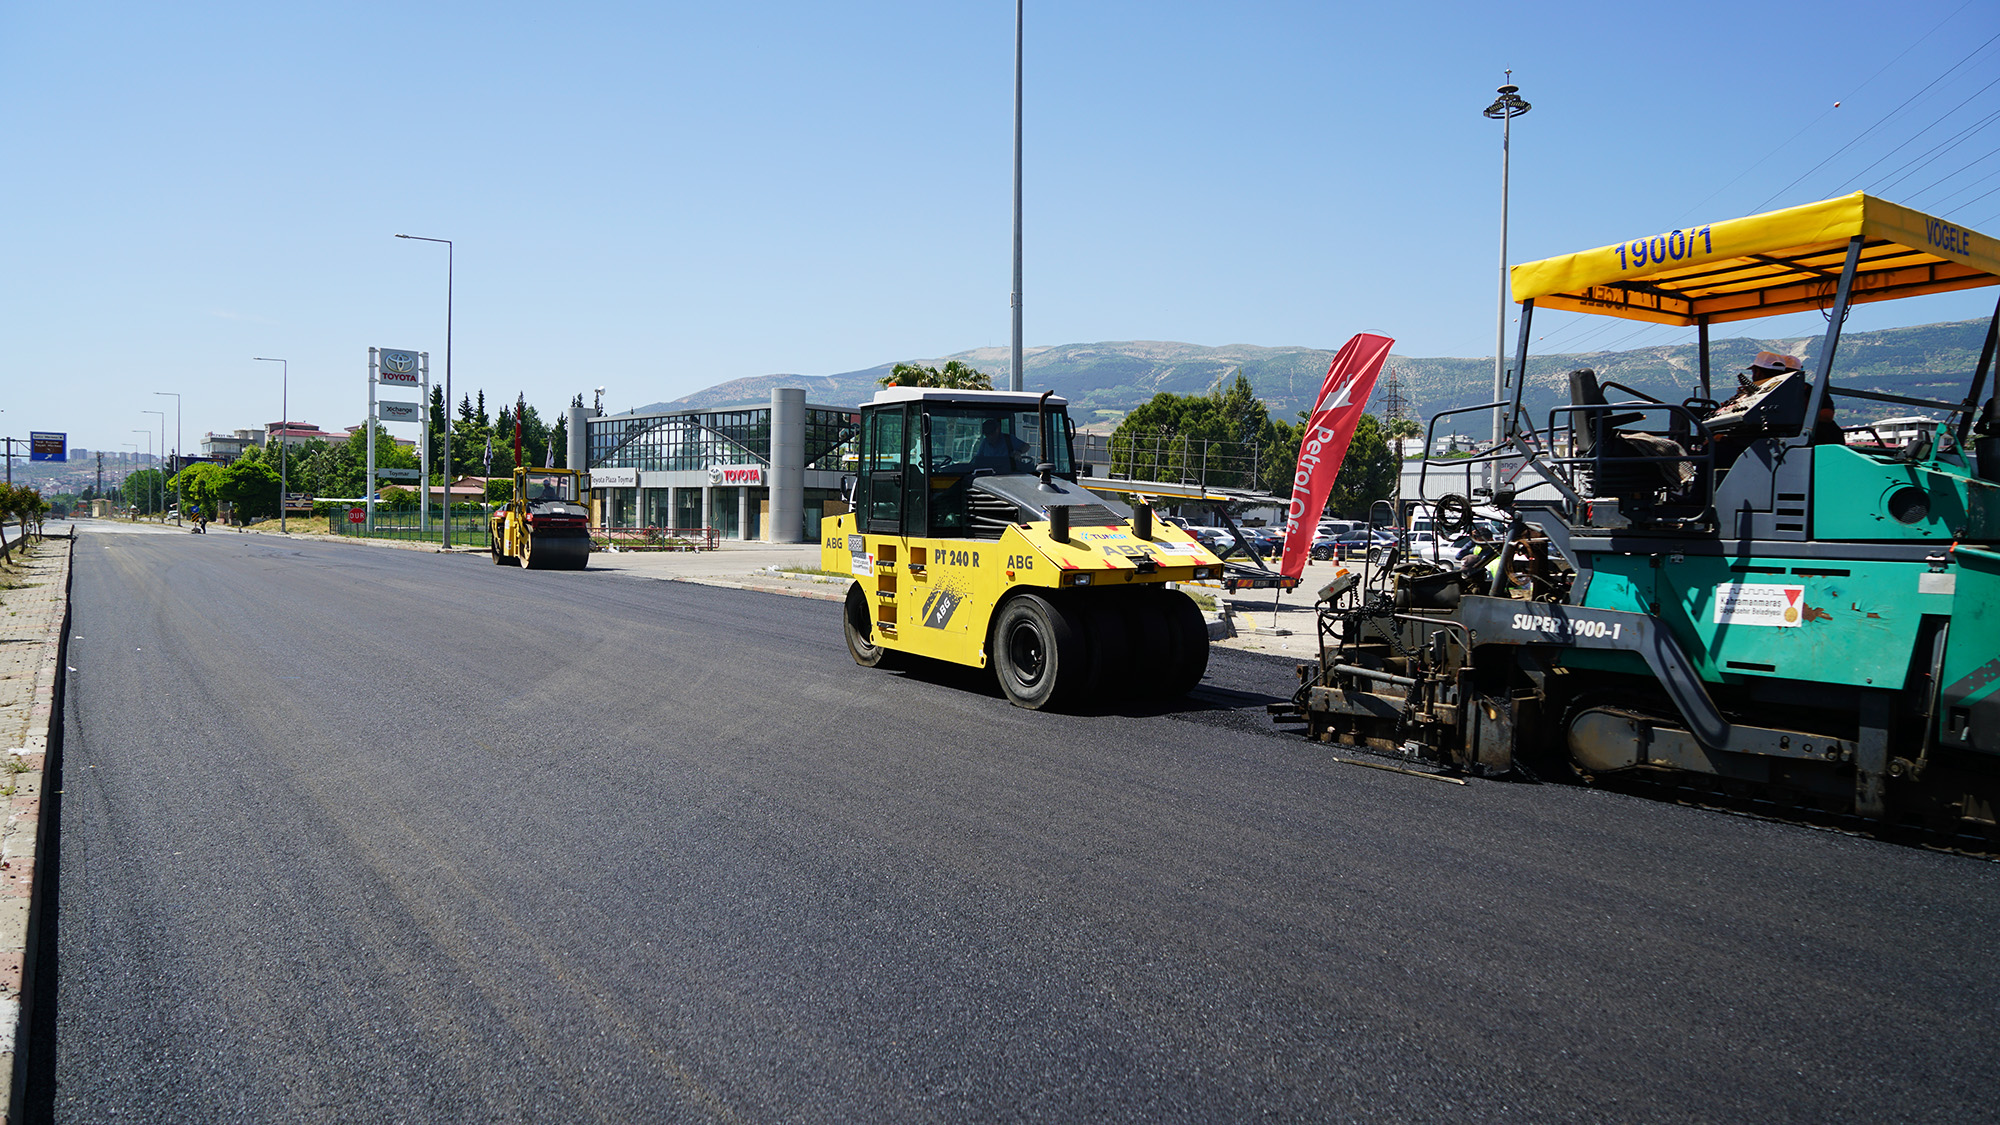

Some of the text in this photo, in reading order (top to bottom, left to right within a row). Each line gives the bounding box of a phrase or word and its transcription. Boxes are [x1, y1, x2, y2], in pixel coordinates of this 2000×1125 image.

[1925, 217, 1970, 257] VÖGELE
[1614, 224, 1713, 270] 1900/1
[382, 372, 417, 382] TOYOTA
[1293, 423, 1335, 495] Petrol
[388, 470, 410, 478] Toymar
[618, 475, 634, 485] Toymar
[723, 469, 760, 482] TOYOTA
[349, 512, 365, 520] DUR
[826, 537, 843, 549] ABG
[1103, 544, 1157, 556] ABG
[934, 548, 980, 568] PT 240 R
[1006, 554, 1033, 570] ABG
[935, 597, 951, 624] ABG
[1511, 613, 1622, 640] SUPER 1900-1
